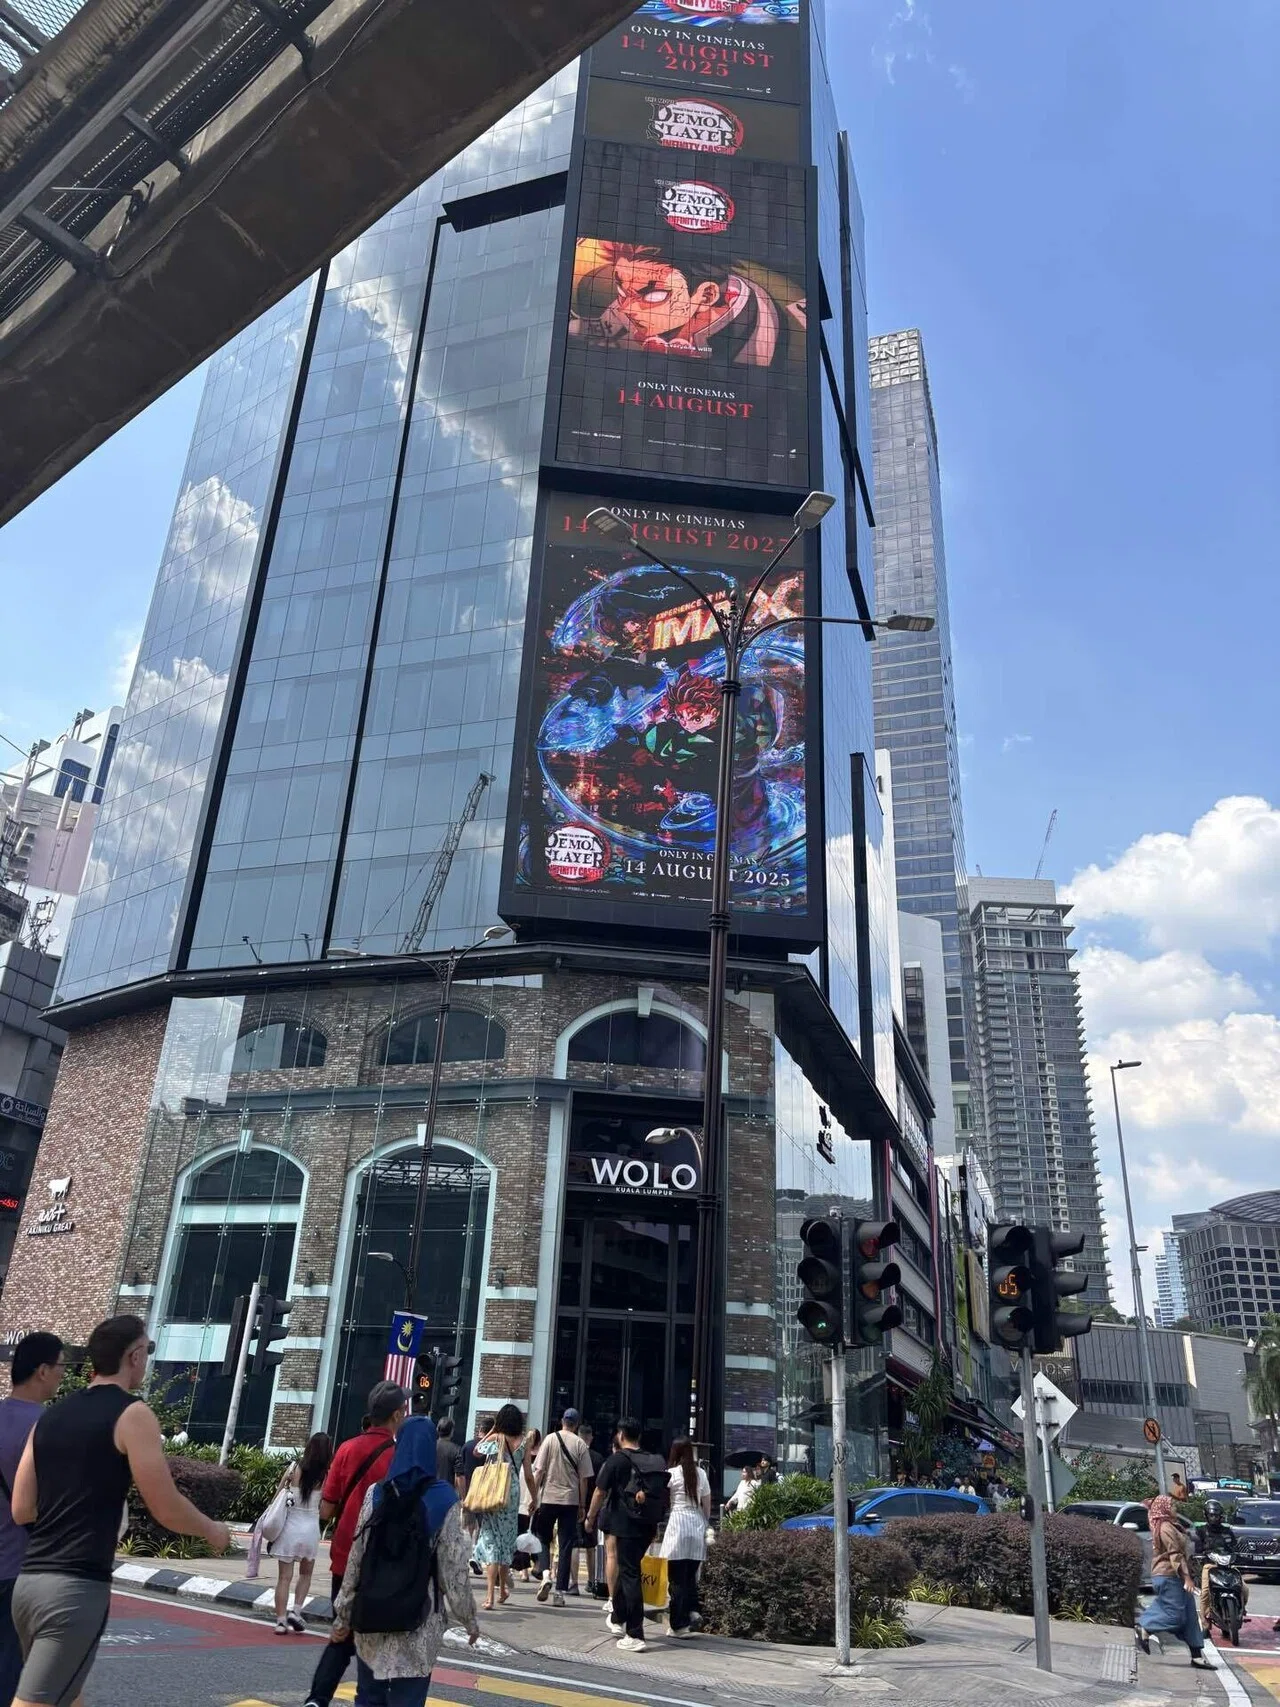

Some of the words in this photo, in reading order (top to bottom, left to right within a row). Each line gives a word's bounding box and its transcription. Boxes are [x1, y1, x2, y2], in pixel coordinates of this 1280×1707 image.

[631, 25, 670, 37] ONLY
[676, 31, 691, 40] IN
[697, 34, 765, 50] CINEMAS
[621, 34, 647, 50] 14
[657, 40, 774, 67] AUGUST
[665, 56, 728, 77] 2025
[652, 104, 735, 131] DEMON
[647, 121, 736, 147] SLAYER
[660, 187, 728, 209] DEMON
[656, 201, 728, 222] SLAYER
[638, 381, 668, 392] ONLY
[670, 385, 682, 393] IN
[684, 387, 735, 399] CINEMAS
[619, 388, 643, 406] 14
[650, 394, 753, 418] AUGUST
[562, 515, 589, 533] 14
[611, 506, 651, 520] ONLY
[655, 511, 671, 522] IN
[676, 514, 745, 529] CINEMAS
[545, 832, 604, 851] DEMON
[544, 847, 604, 868] SLAYER
[660, 850, 688, 860] ONLY
[692, 852, 703, 860] IN
[626, 860, 647, 874] 14
[652, 862, 738, 882] AUGUT
[744, 870, 790, 887] 2025
[591, 1158, 697, 1191] WOLO
[616, 1187, 640, 1195] KUALA
[642, 1188, 673, 1196] LUMPUR
